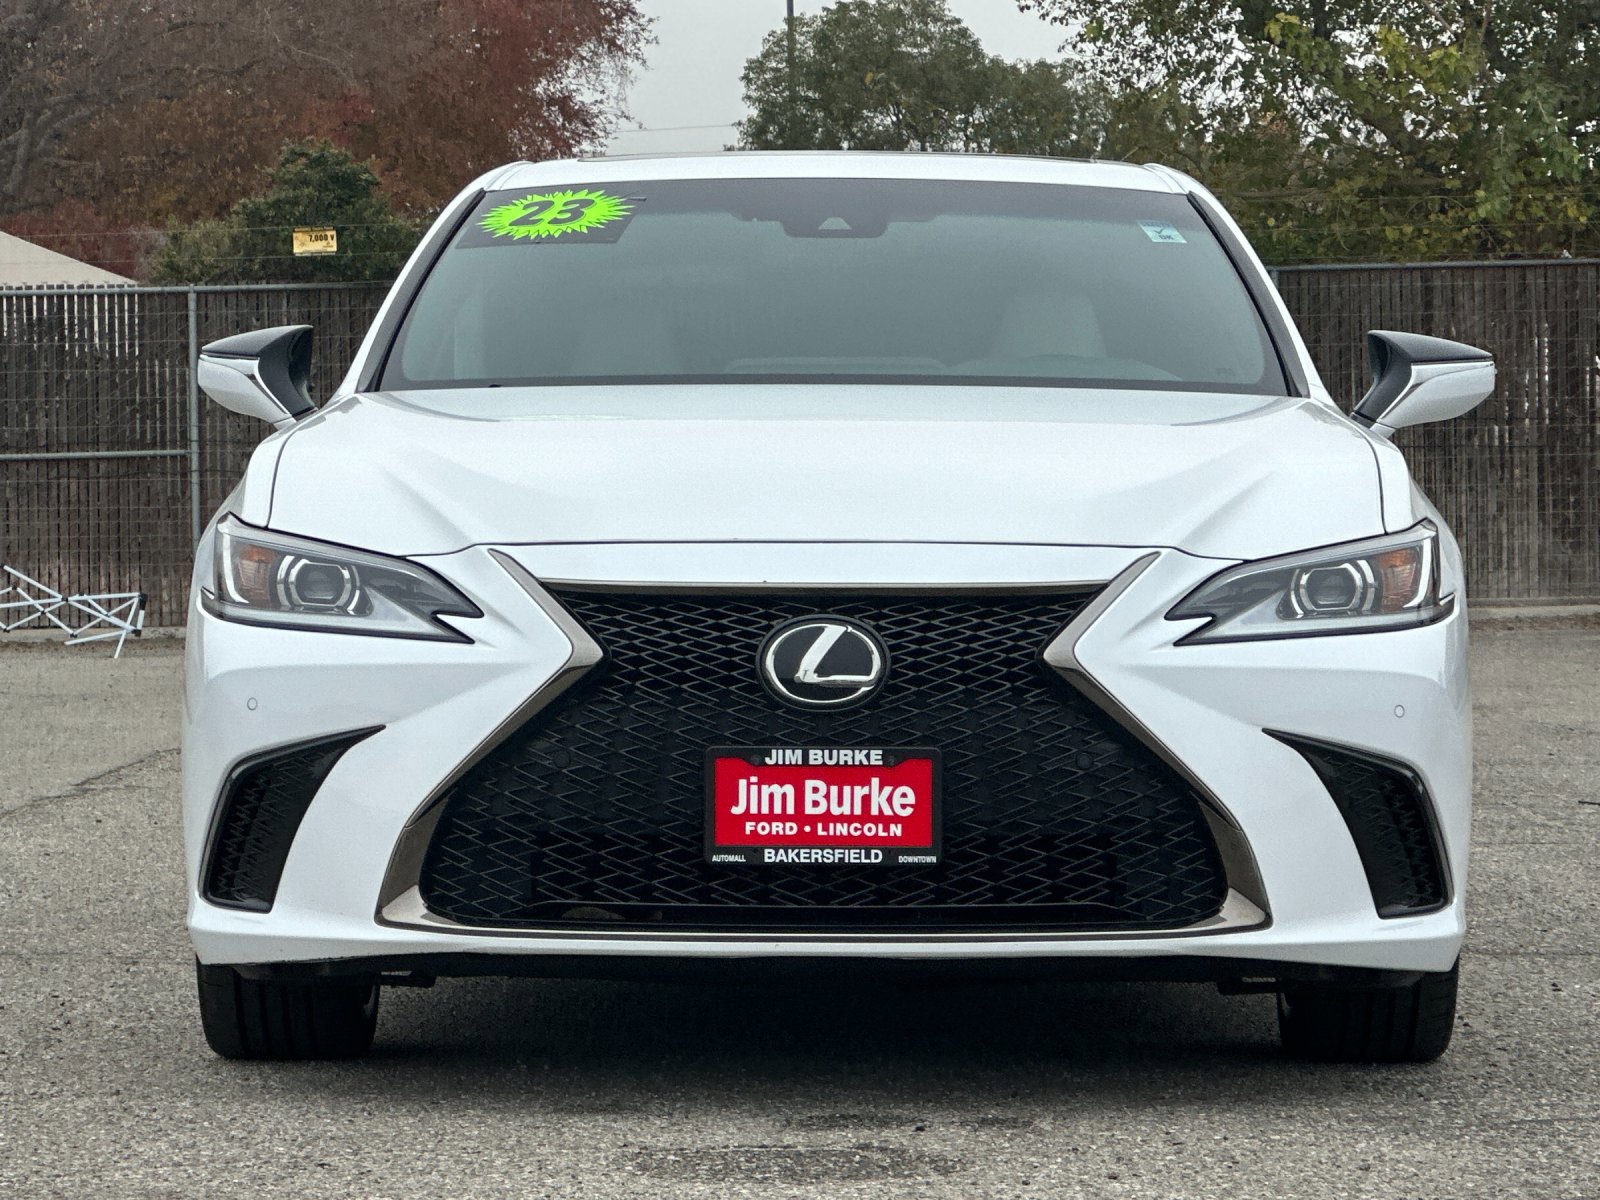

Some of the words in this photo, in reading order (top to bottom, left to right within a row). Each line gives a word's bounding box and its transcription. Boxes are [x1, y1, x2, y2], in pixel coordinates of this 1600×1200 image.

[508, 198, 596, 226] 23
[309, 234, 328, 243] 7,000
[765, 749, 802, 765] JIM
[808, 749, 883, 765] BURKE
[730, 776, 795, 815] Jim
[804, 777, 916, 817] Burke
[745, 821, 798, 835] FORD
[817, 823, 902, 837] LINCOLN
[712, 854, 746, 863] AUTOMALL
[764, 849, 883, 864] BAKERSFIELD
[898, 855, 937, 863] DOWNTOWN
